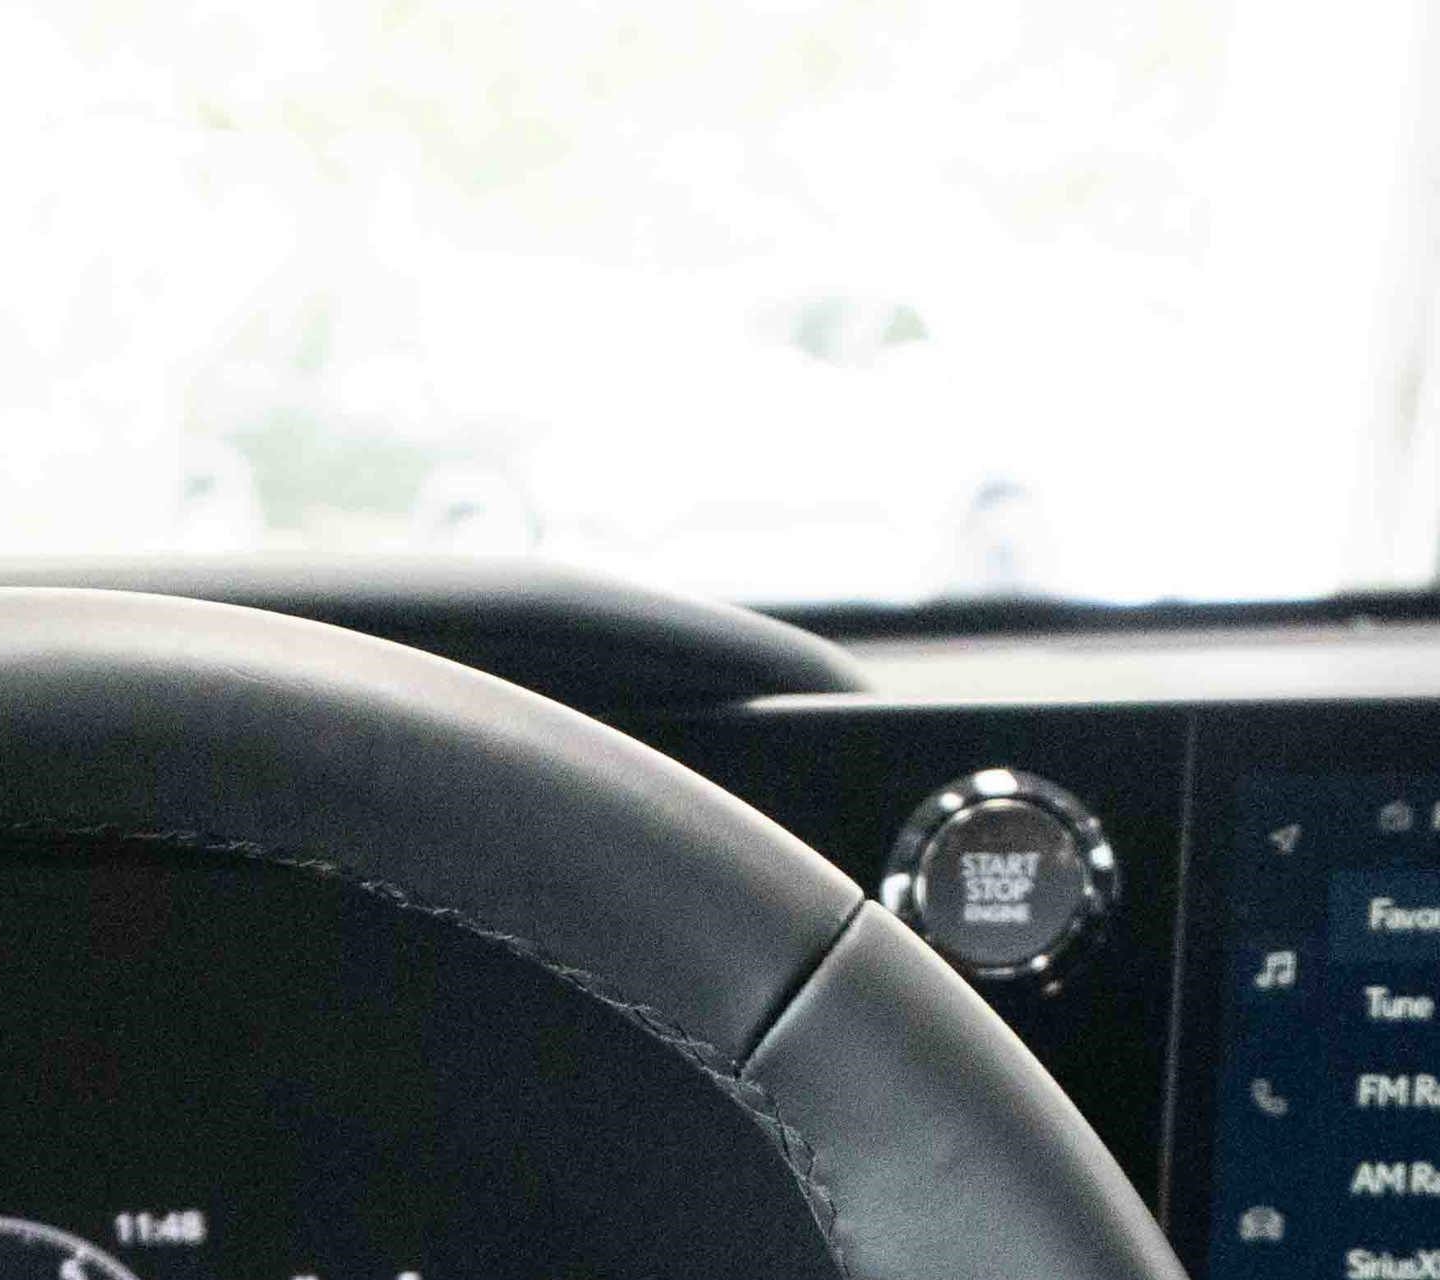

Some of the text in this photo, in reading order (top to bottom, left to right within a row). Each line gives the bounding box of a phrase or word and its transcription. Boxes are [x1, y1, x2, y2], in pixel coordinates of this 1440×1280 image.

[961, 852, 1040, 877] START
[966, 877, 1035, 901] STOP
[1365, 986, 1435, 1021] Tune
[1358, 1075, 1410, 1109] FM
[1351, 1163, 1406, 1196] AM
[116, 1210, 206, 1244] 11:48
